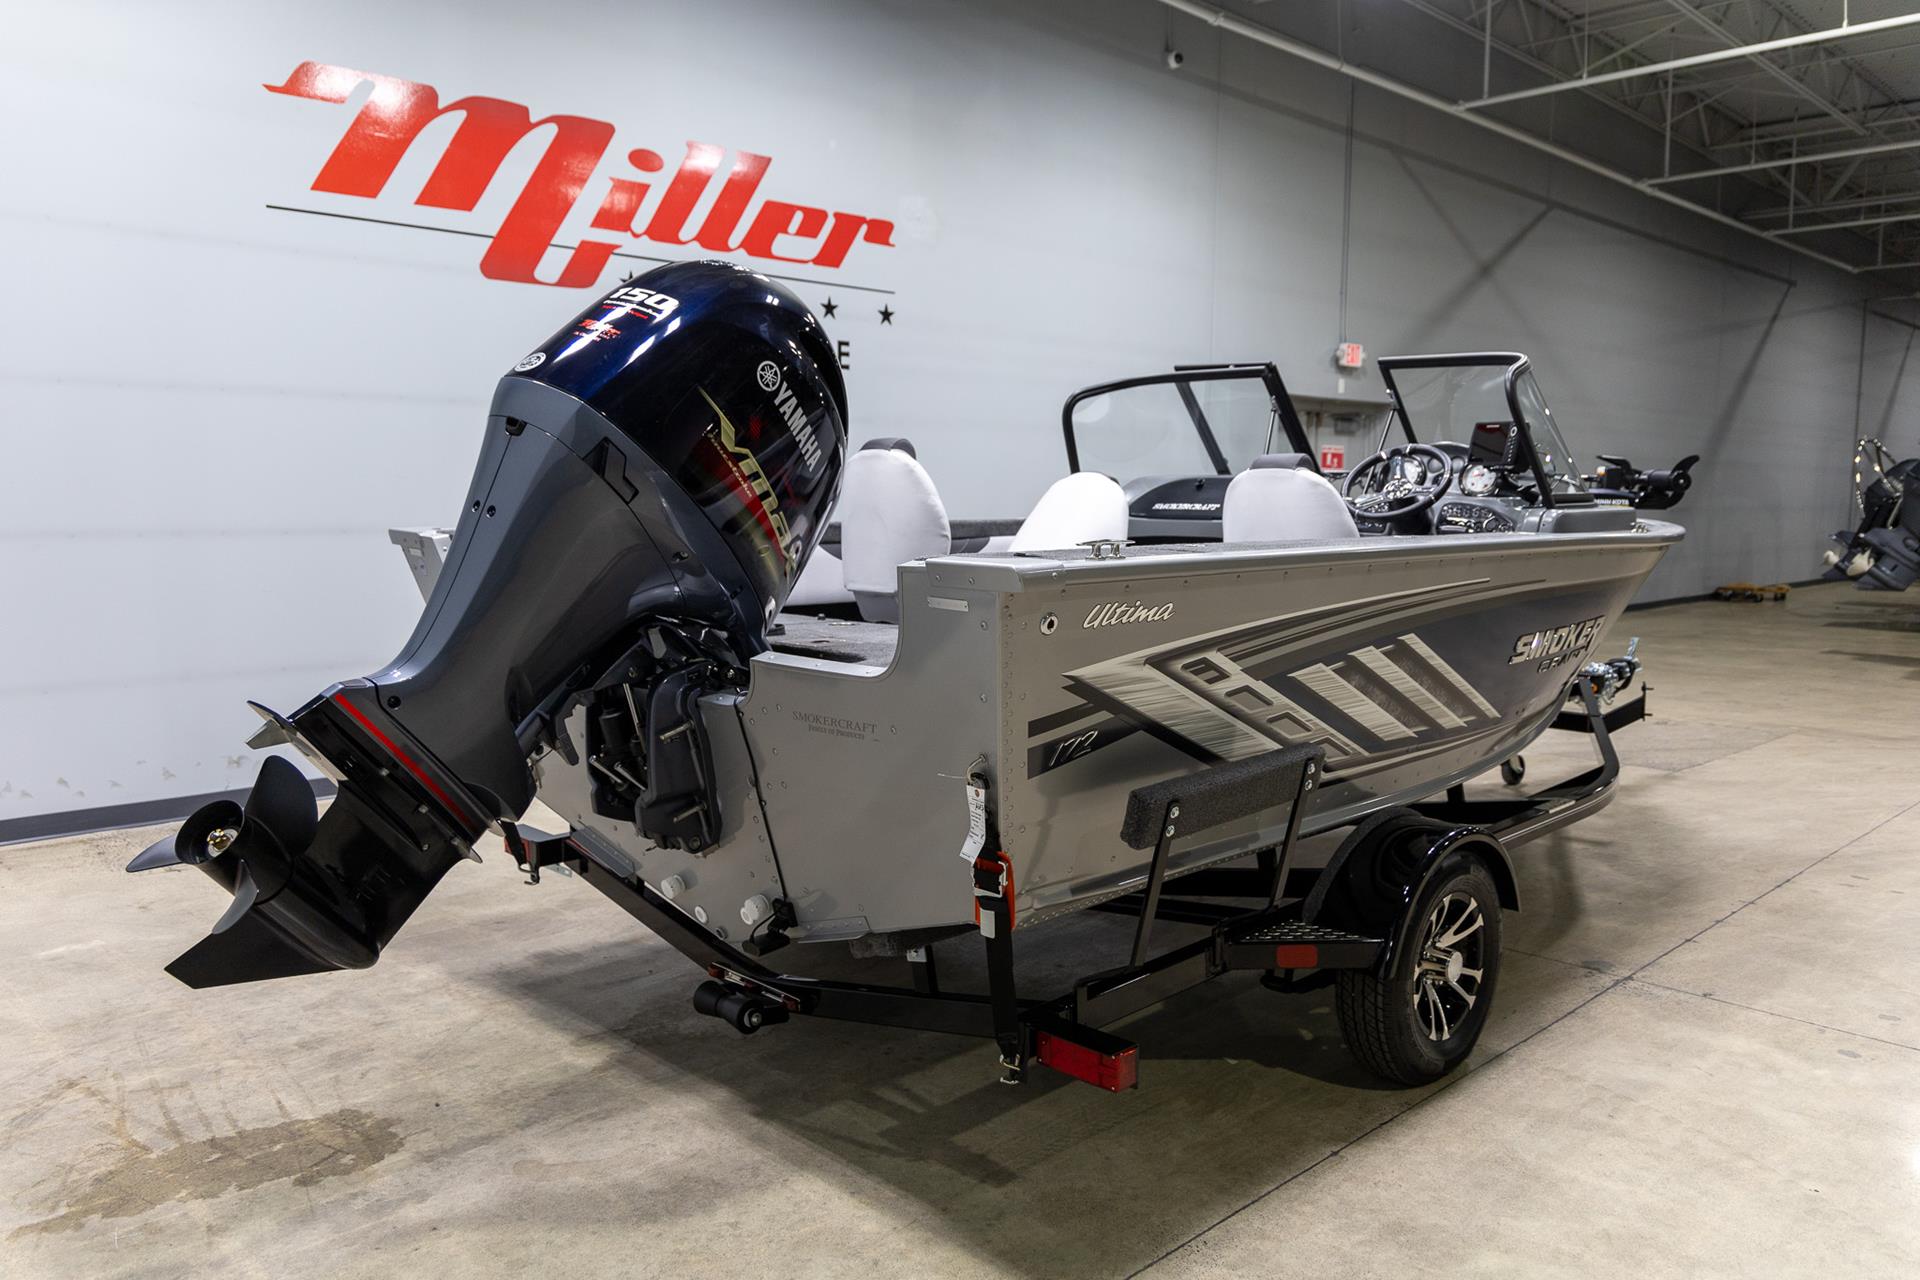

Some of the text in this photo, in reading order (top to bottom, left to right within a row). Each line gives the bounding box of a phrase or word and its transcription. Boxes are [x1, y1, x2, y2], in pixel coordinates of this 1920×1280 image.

[263, 60, 895, 288] Miller
[609, 286, 680, 316] 150
[773, 381, 822, 473] YAMAHA
[1082, 600, 1176, 629] Ultima
[1508, 614, 1607, 665] SMOKER
[792, 710, 878, 735] SMOKERCRAFT
[1049, 730, 1099, 767] 172
